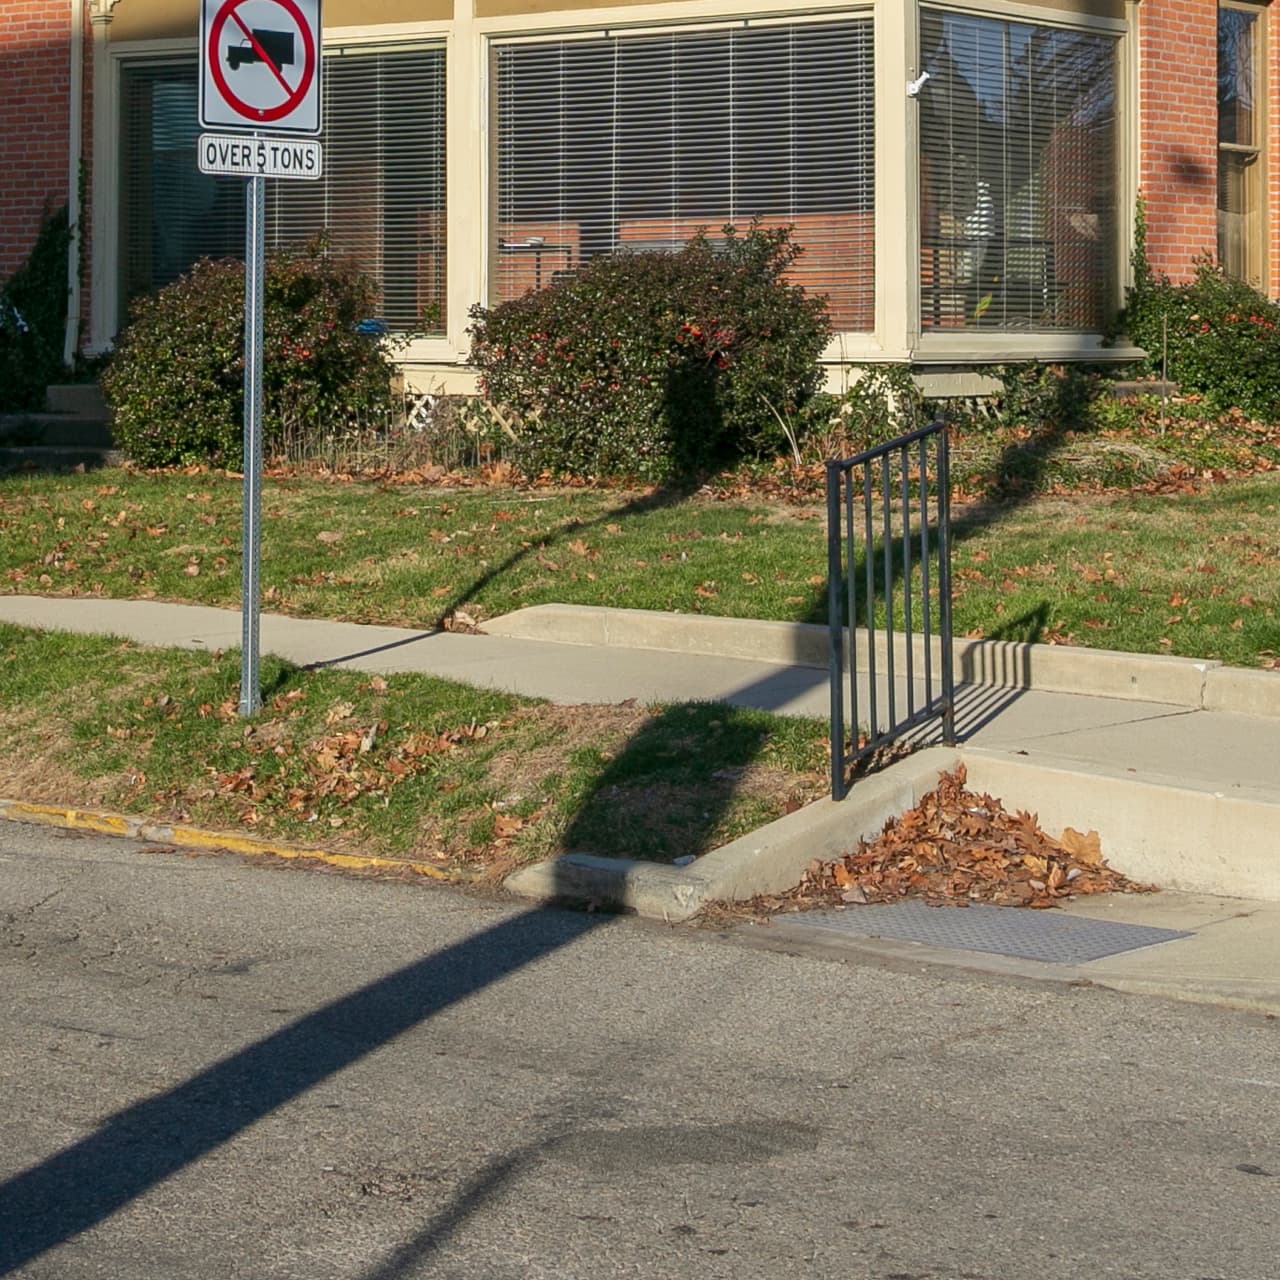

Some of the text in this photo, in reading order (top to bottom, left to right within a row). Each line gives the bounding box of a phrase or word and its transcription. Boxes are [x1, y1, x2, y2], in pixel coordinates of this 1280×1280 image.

[206, 143, 315, 170] OVER 5 TONS
